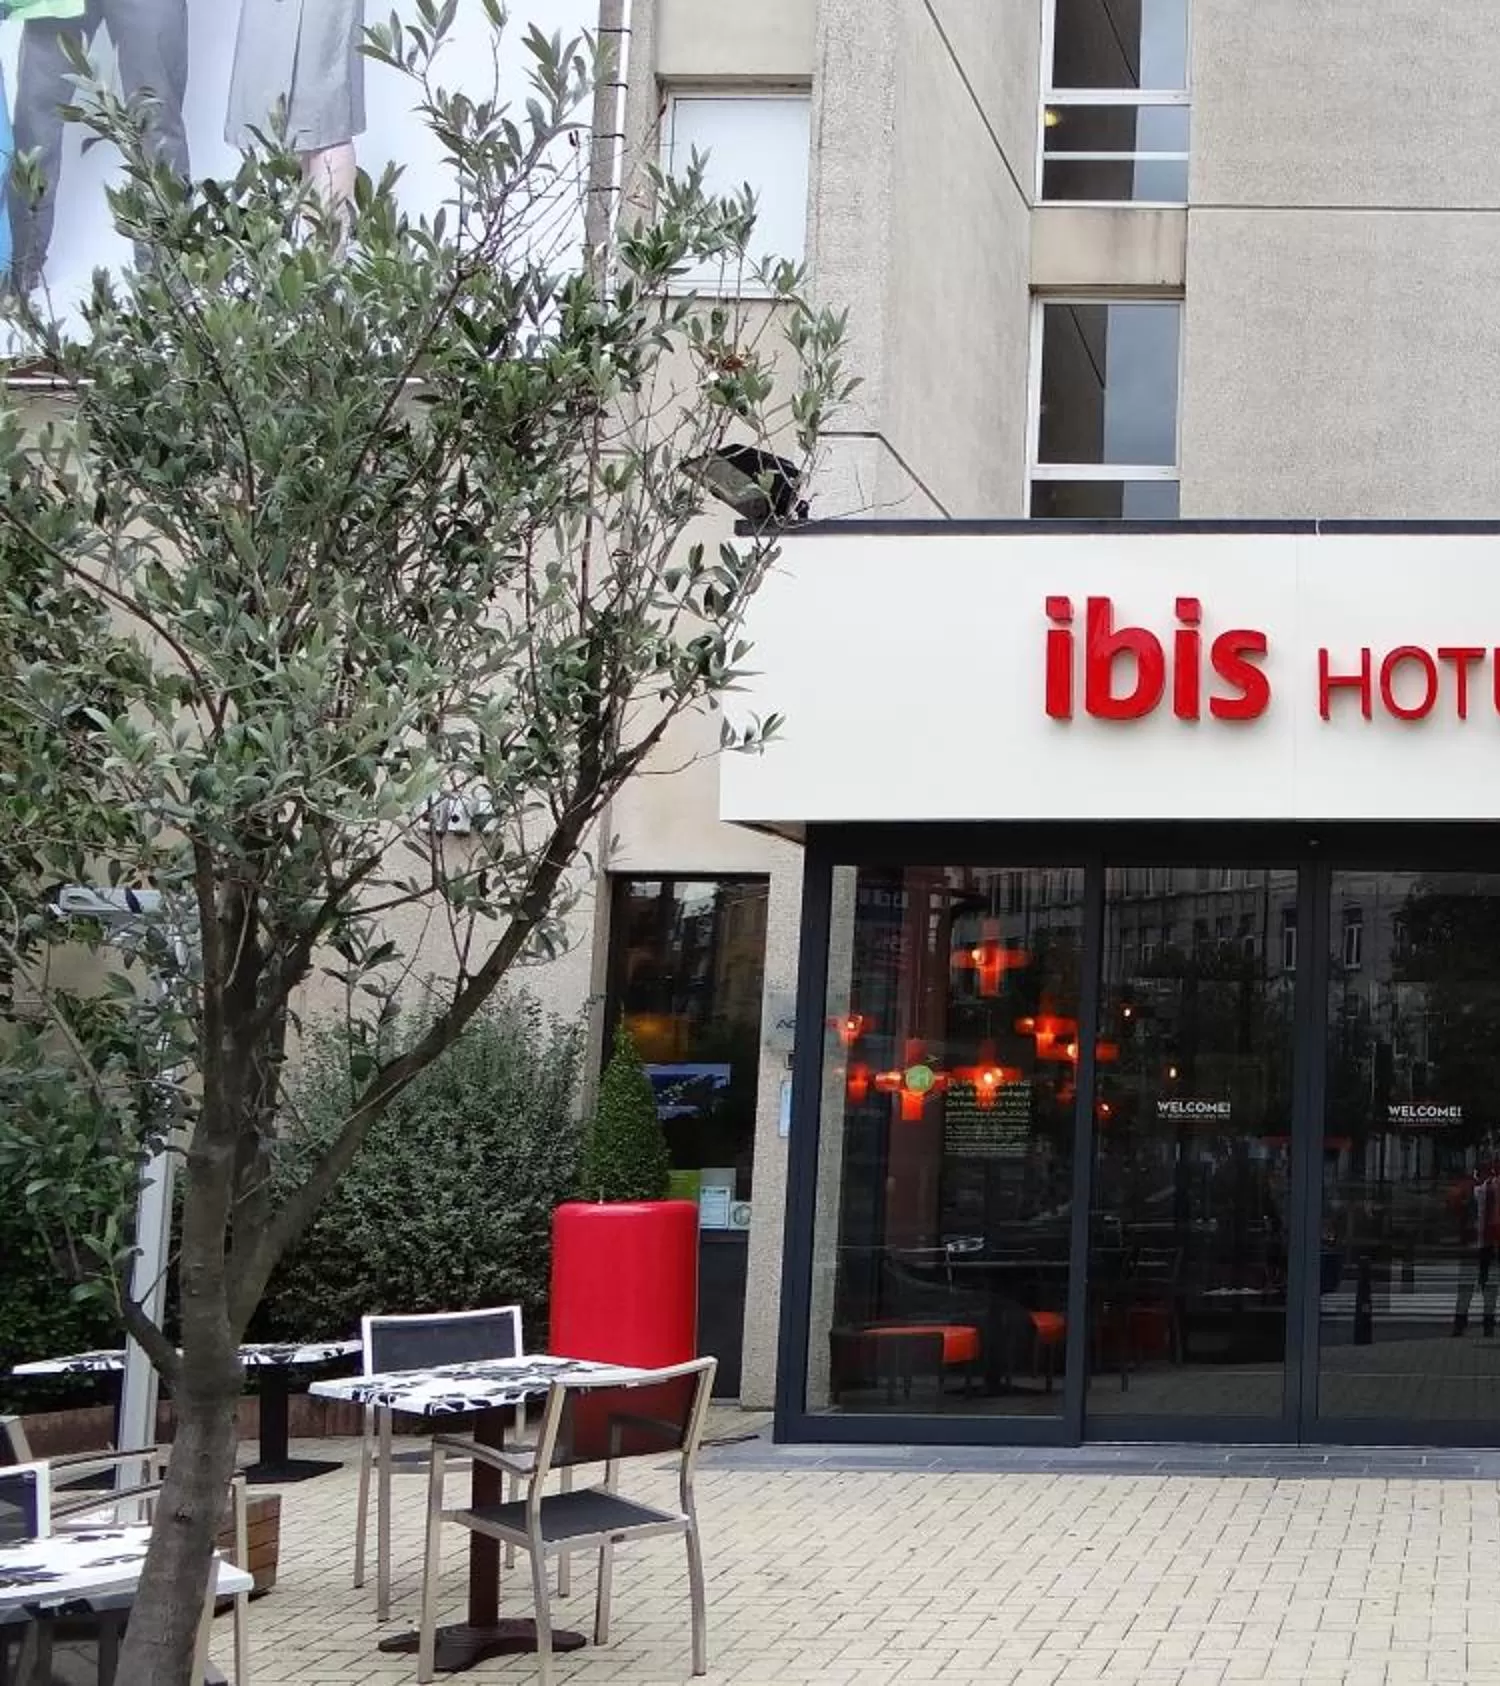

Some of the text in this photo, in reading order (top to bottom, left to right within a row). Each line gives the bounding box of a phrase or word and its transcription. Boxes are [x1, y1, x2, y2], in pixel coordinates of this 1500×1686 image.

[1045, 596, 1271, 721] ibis
[1156, 1100, 1232, 1114] WELCOME!
[1387, 1104, 1463, 1117] WELCOME!
